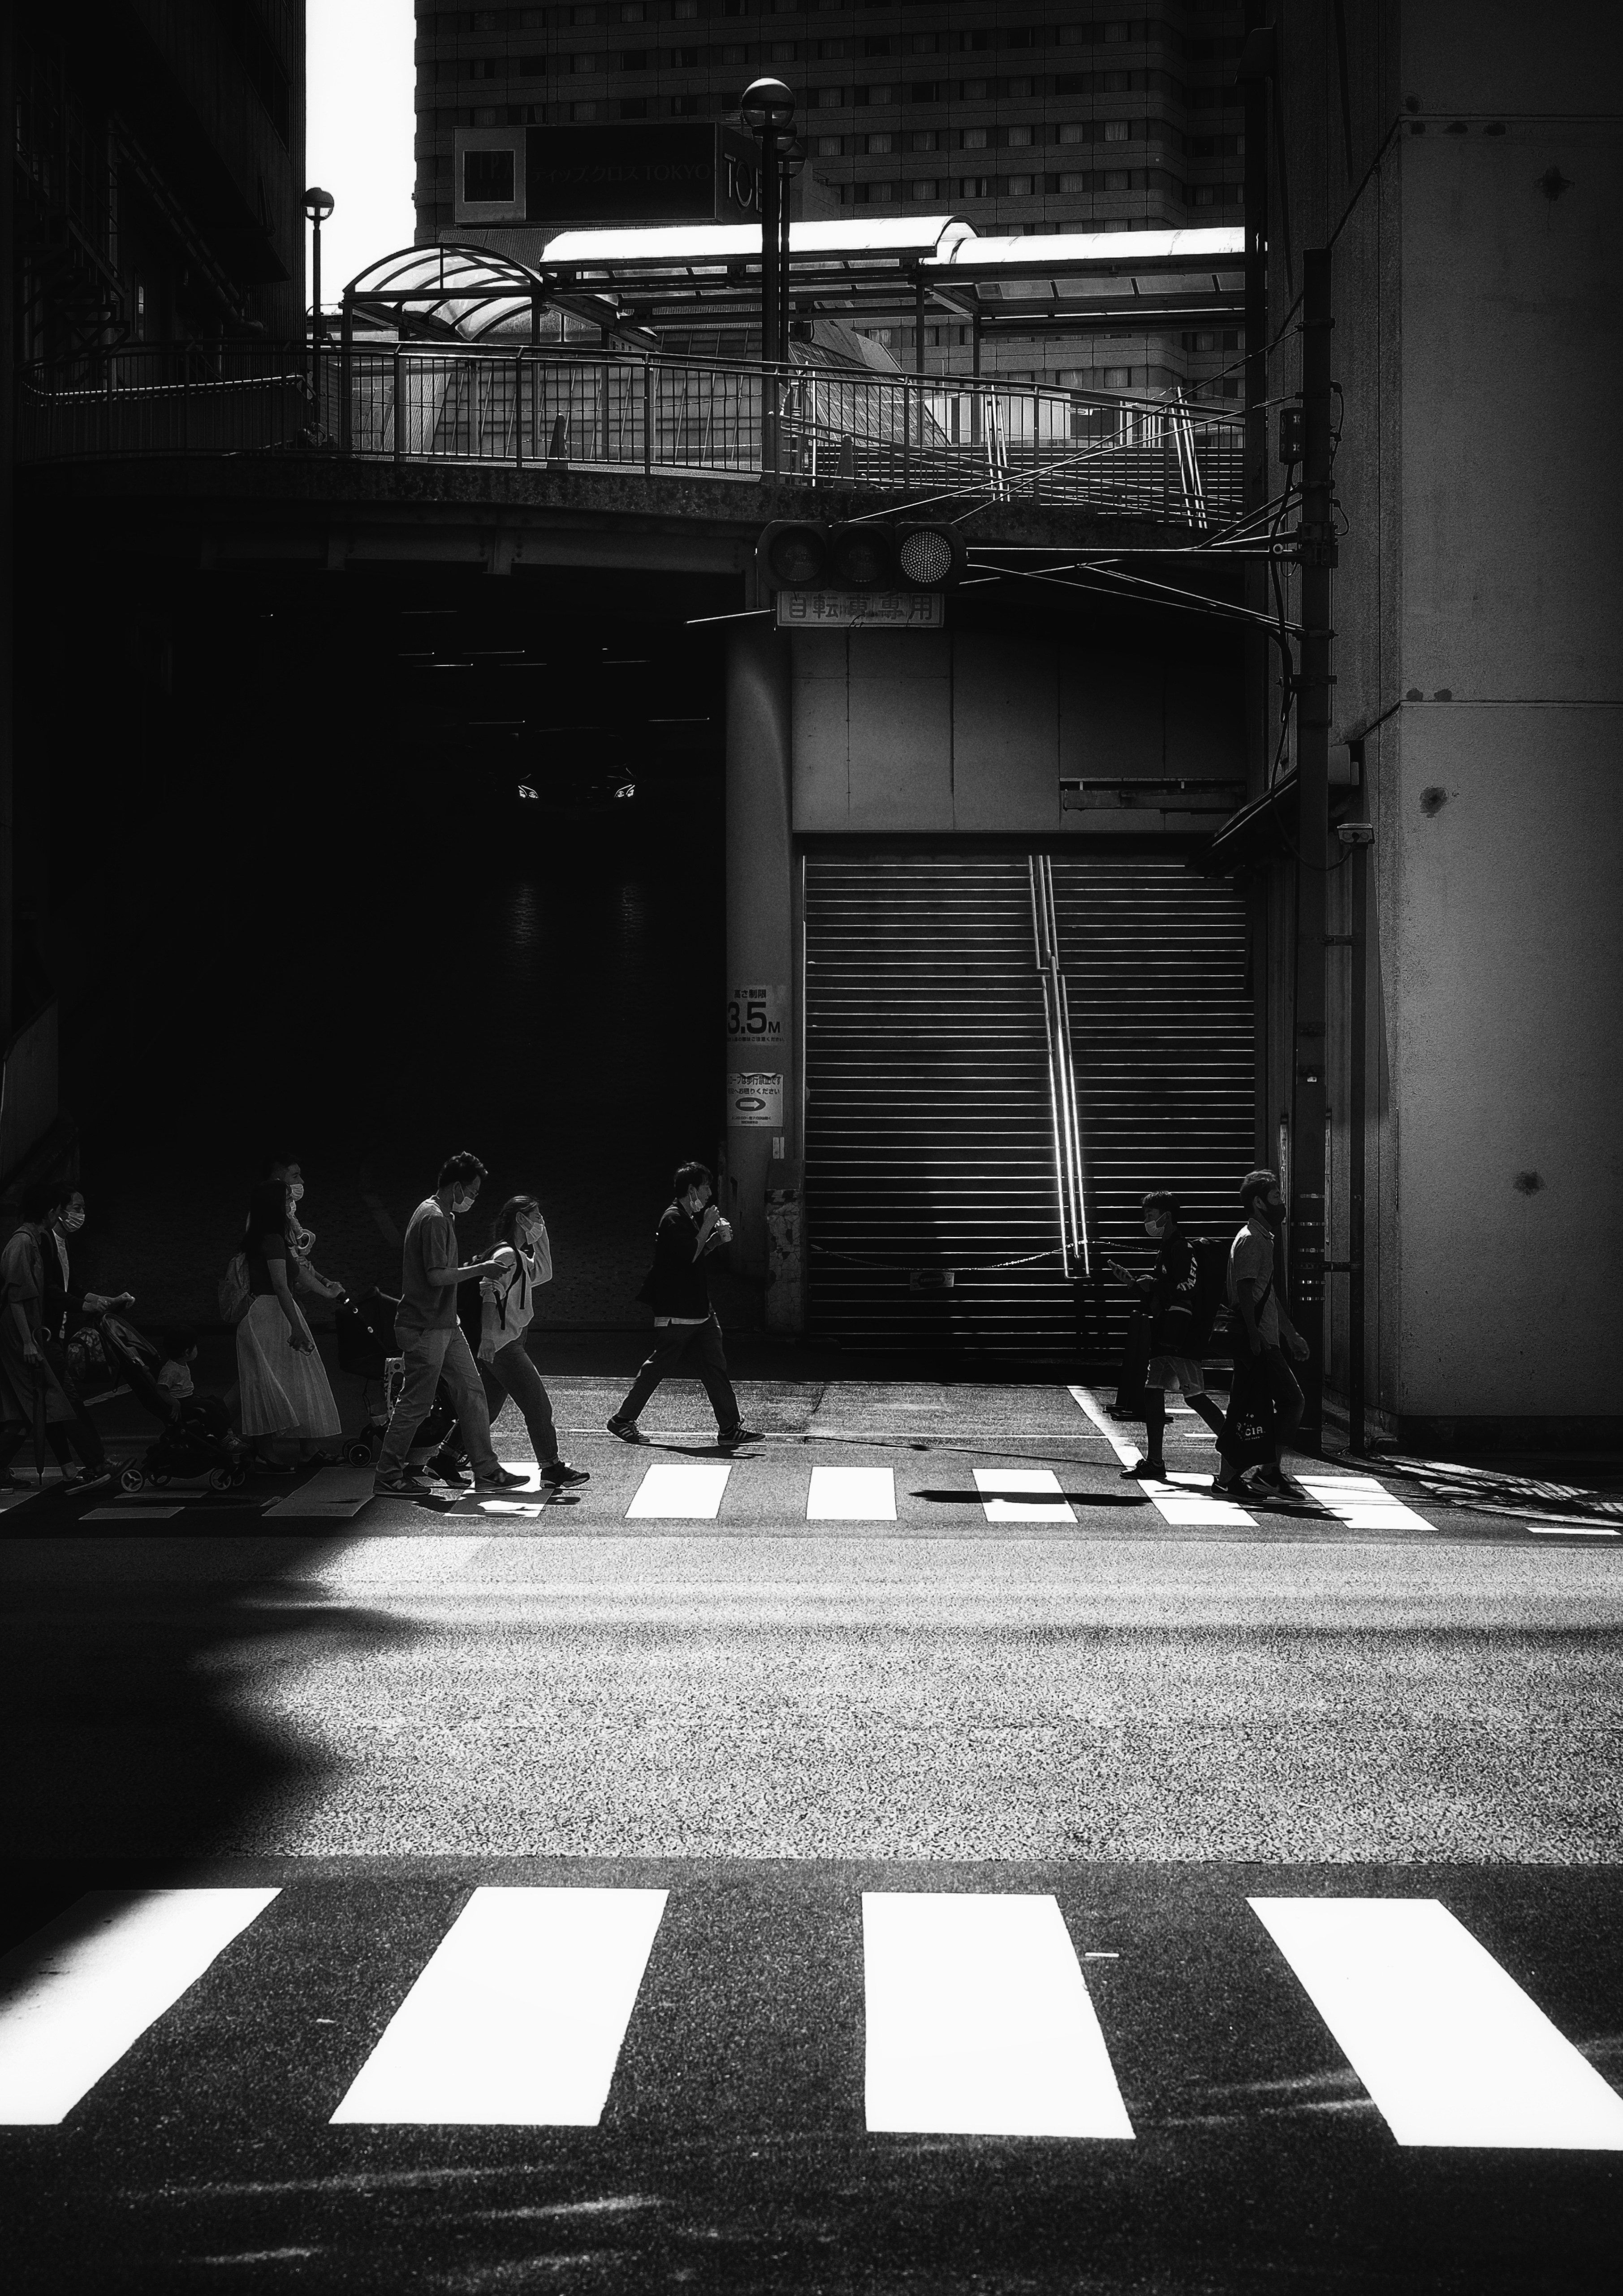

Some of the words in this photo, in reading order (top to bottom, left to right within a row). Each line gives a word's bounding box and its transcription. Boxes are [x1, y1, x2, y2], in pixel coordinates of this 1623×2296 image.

[643, 164, 712, 181] TOKYO
[789, 594, 933, 620] 自転車専用
[734, 989, 767, 999] 高さ制限
